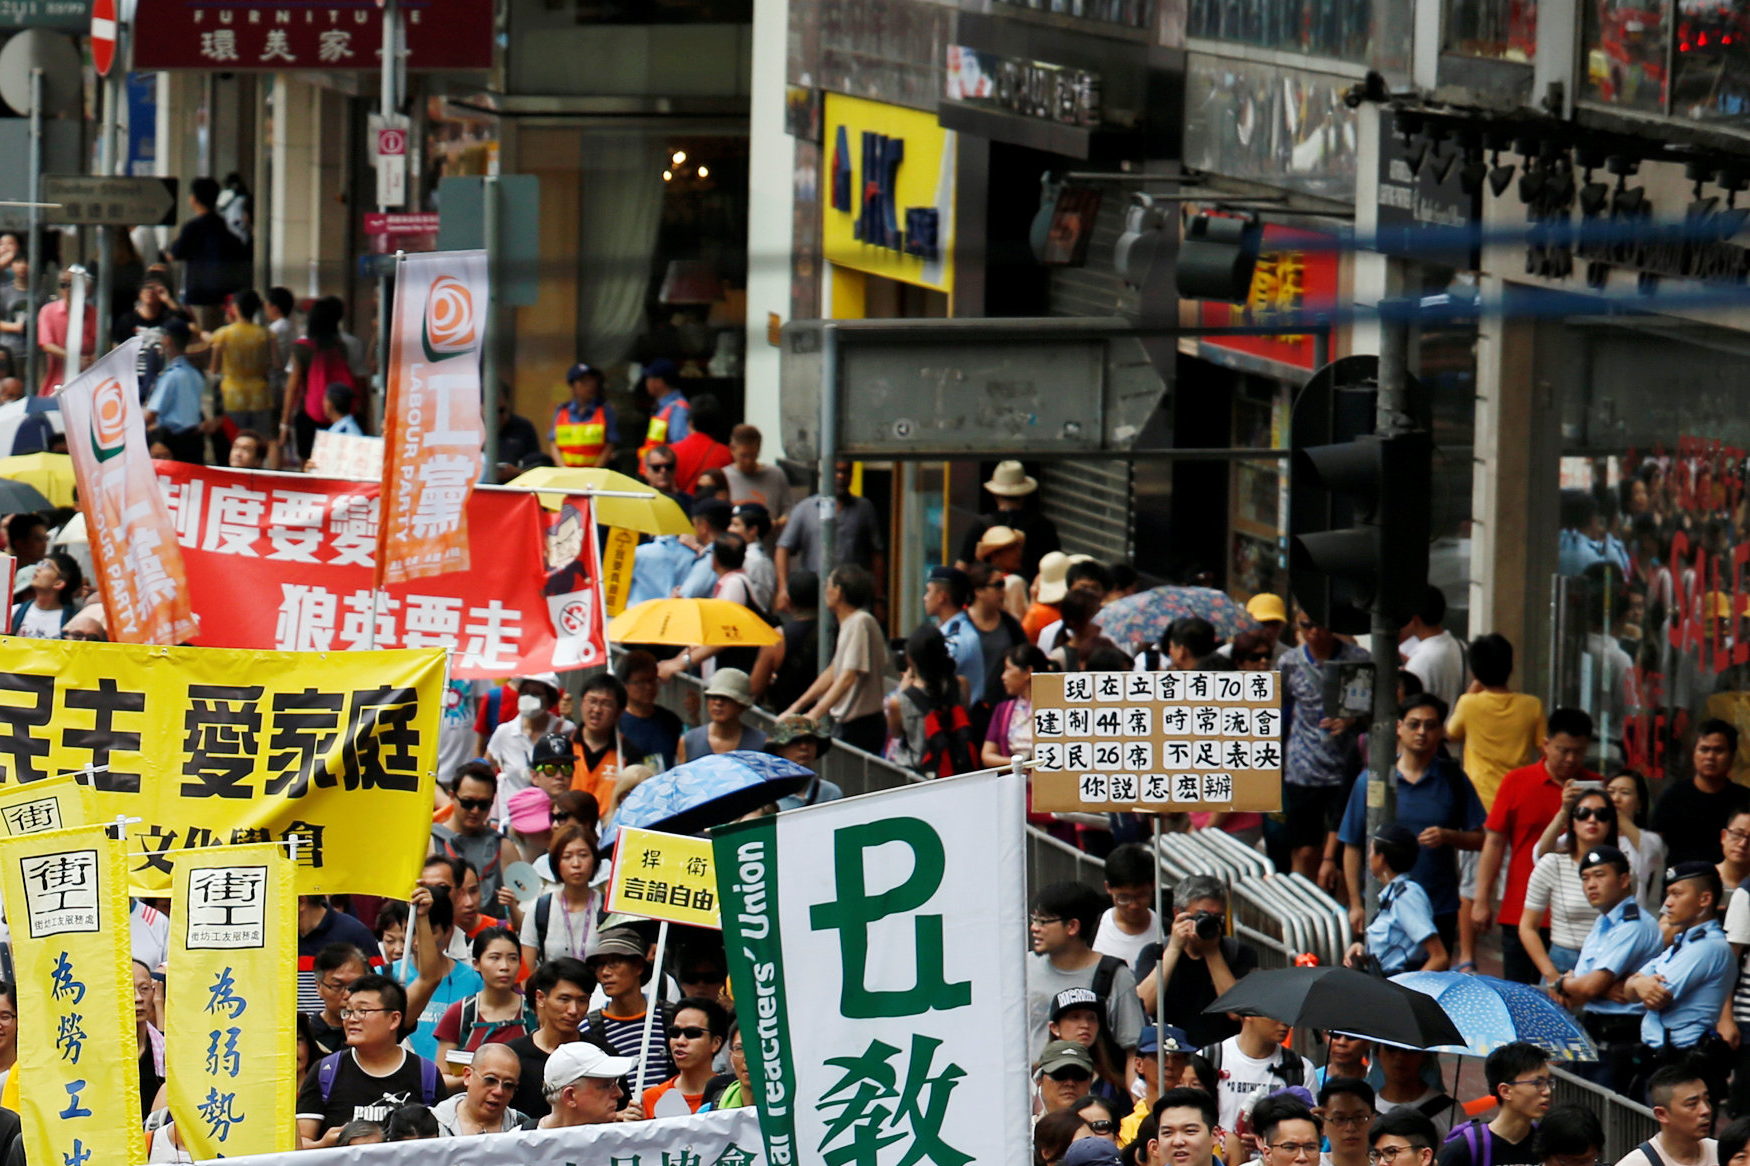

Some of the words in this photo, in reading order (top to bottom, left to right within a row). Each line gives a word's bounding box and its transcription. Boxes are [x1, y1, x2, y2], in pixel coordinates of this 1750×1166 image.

[194, 10, 422, 24] FURNITUE
[200, 29, 413, 62] 環美家
[406, 362, 425, 458] LABOUR
[412, 373, 481, 540] 工黨
[395, 459, 418, 544] PARTY
[275, 583, 524, 671] 狼英要走
[1668, 530, 1749, 673] SALE
[1066, 673, 1268, 701] 現在立會有70席
[180, 684, 420, 800] 愛家庭
[1035, 708, 1148, 735] 建制44席
[1165, 707, 1279, 736] 時常流會
[1037, 743, 1148, 770] 泛民26席
[28, 856, 94, 915] 街工
[640, 849, 707, 878] 捍衛
[735, 840, 768, 940] Union
[193, 872, 263, 927] 街工
[622, 876, 714, 912] 言論自由
[33, 914, 95, 931] 街坊工友服務處
[191, 931, 261, 943] 街坊工友服務處
[196, 966, 248, 1157] 為弱勢
